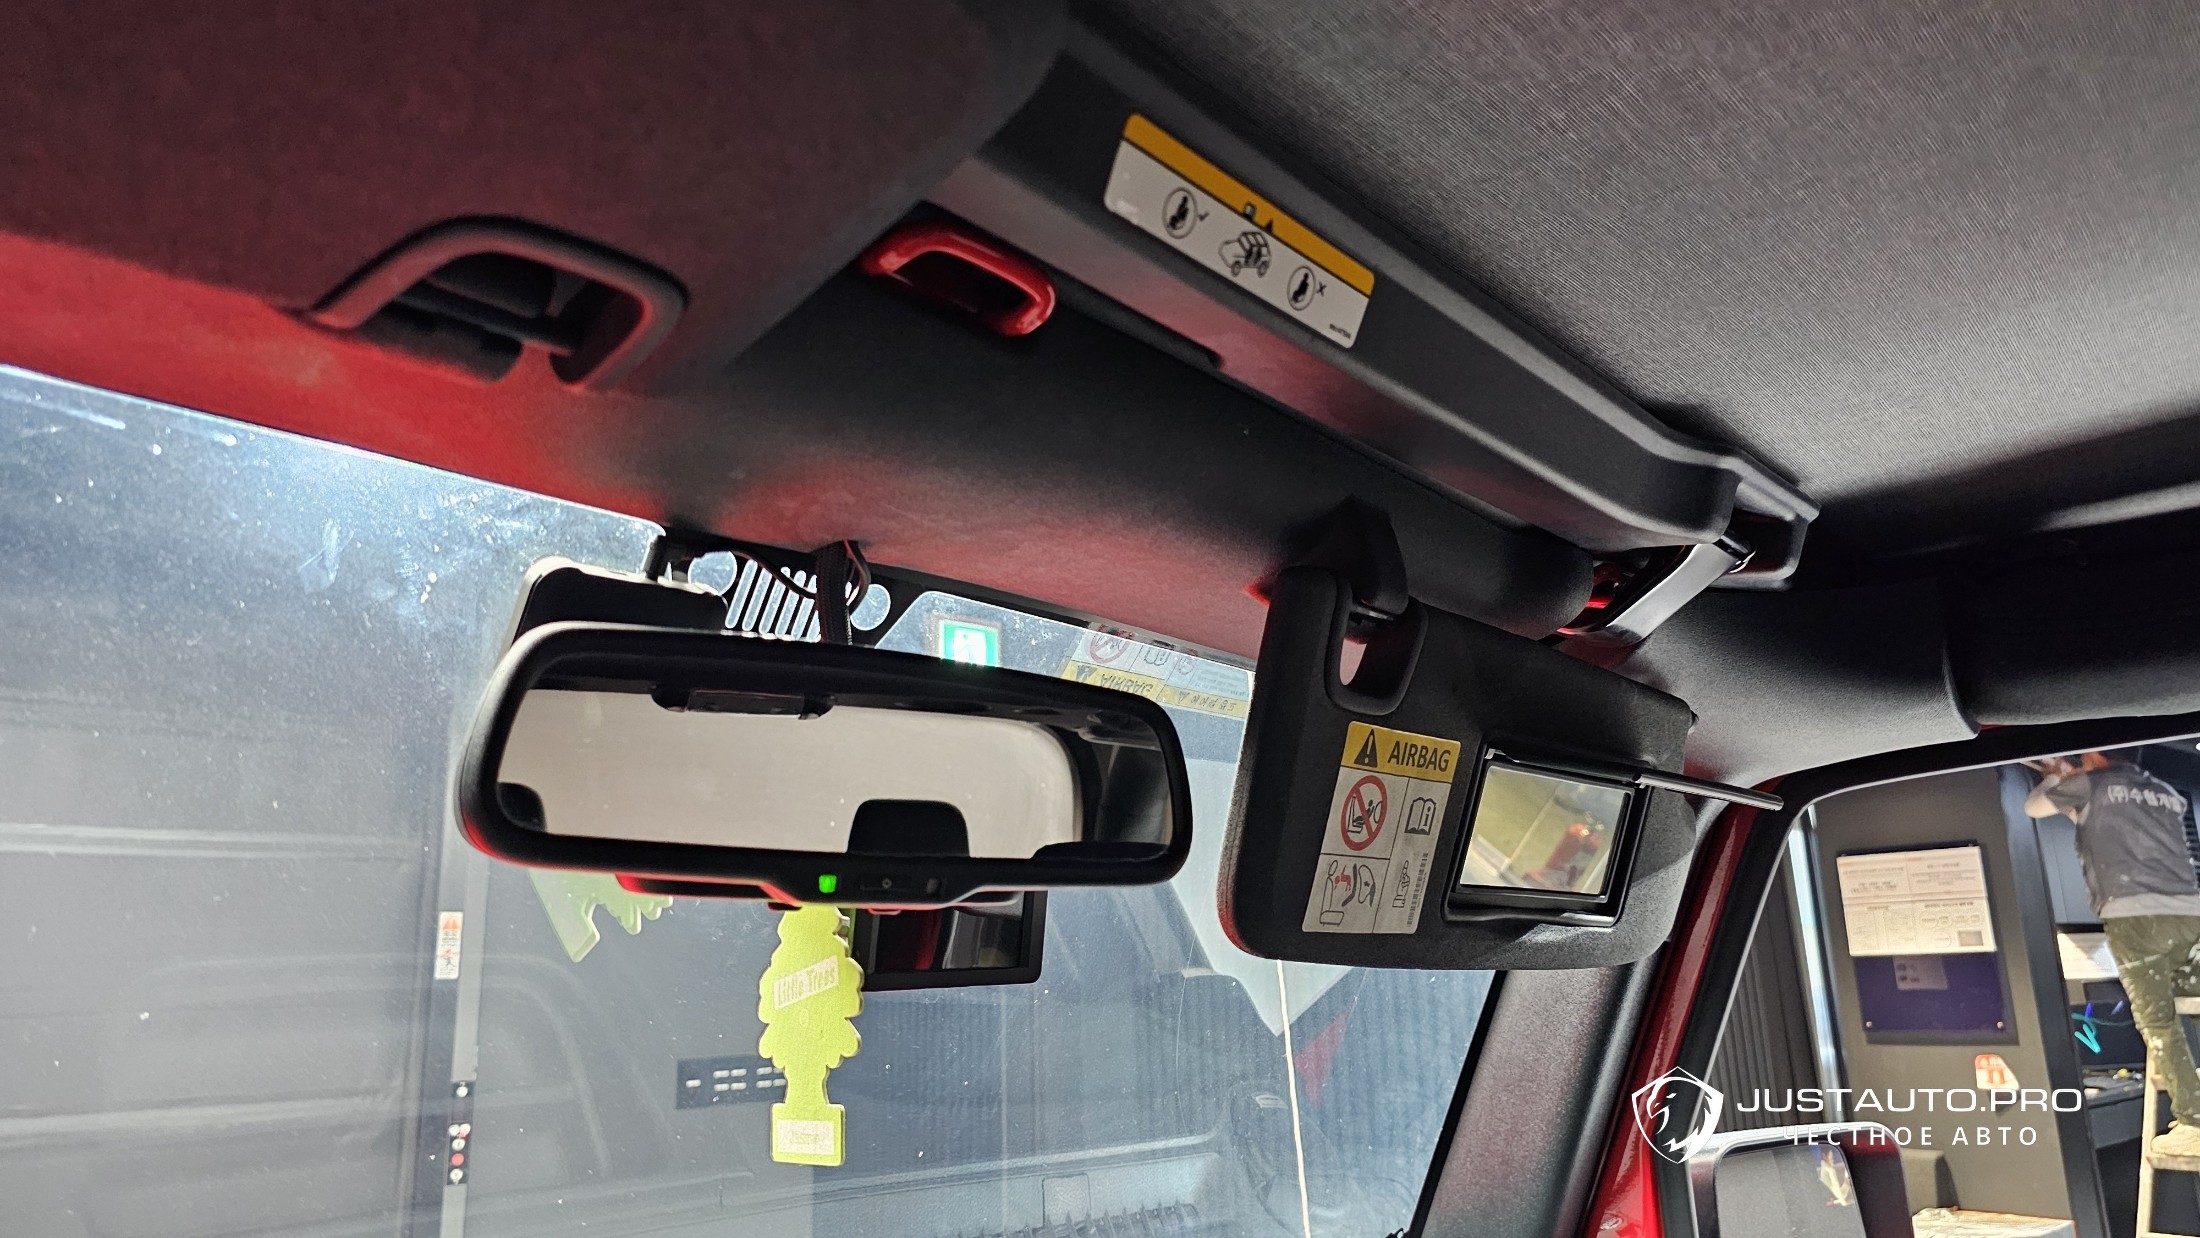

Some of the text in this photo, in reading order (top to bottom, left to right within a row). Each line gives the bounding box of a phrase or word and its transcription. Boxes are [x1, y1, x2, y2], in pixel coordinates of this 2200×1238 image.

[1387, 740, 1452, 773] AIRBAG
[778, 966, 836, 1006] Little Trees
